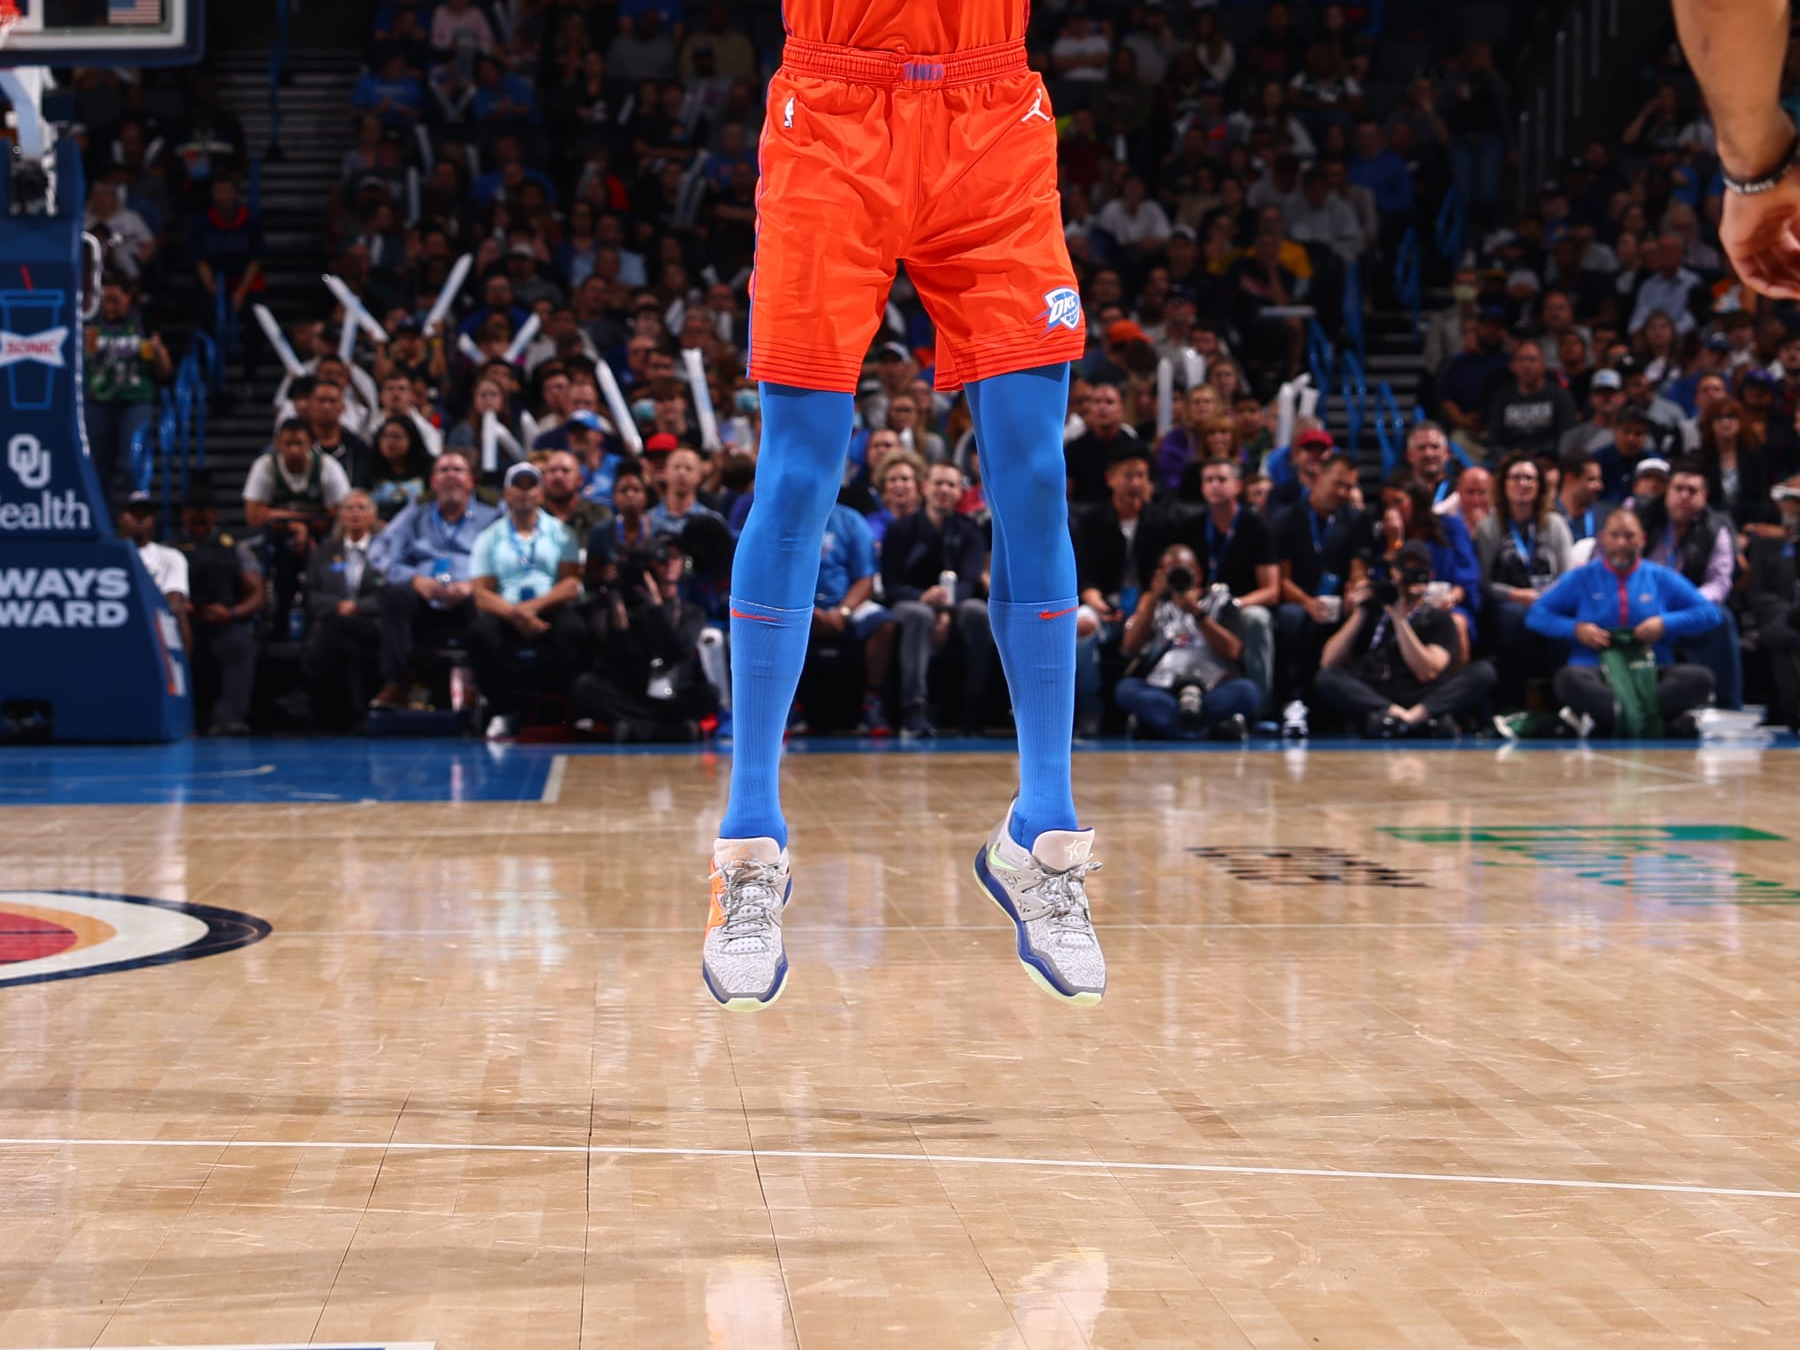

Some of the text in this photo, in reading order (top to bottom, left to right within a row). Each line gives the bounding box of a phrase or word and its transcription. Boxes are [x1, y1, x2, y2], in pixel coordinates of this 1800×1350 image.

[6, 340, 57, 355] SONIC
[8, 433, 51, 488] OU
[0, 490, 91, 530] ealth
